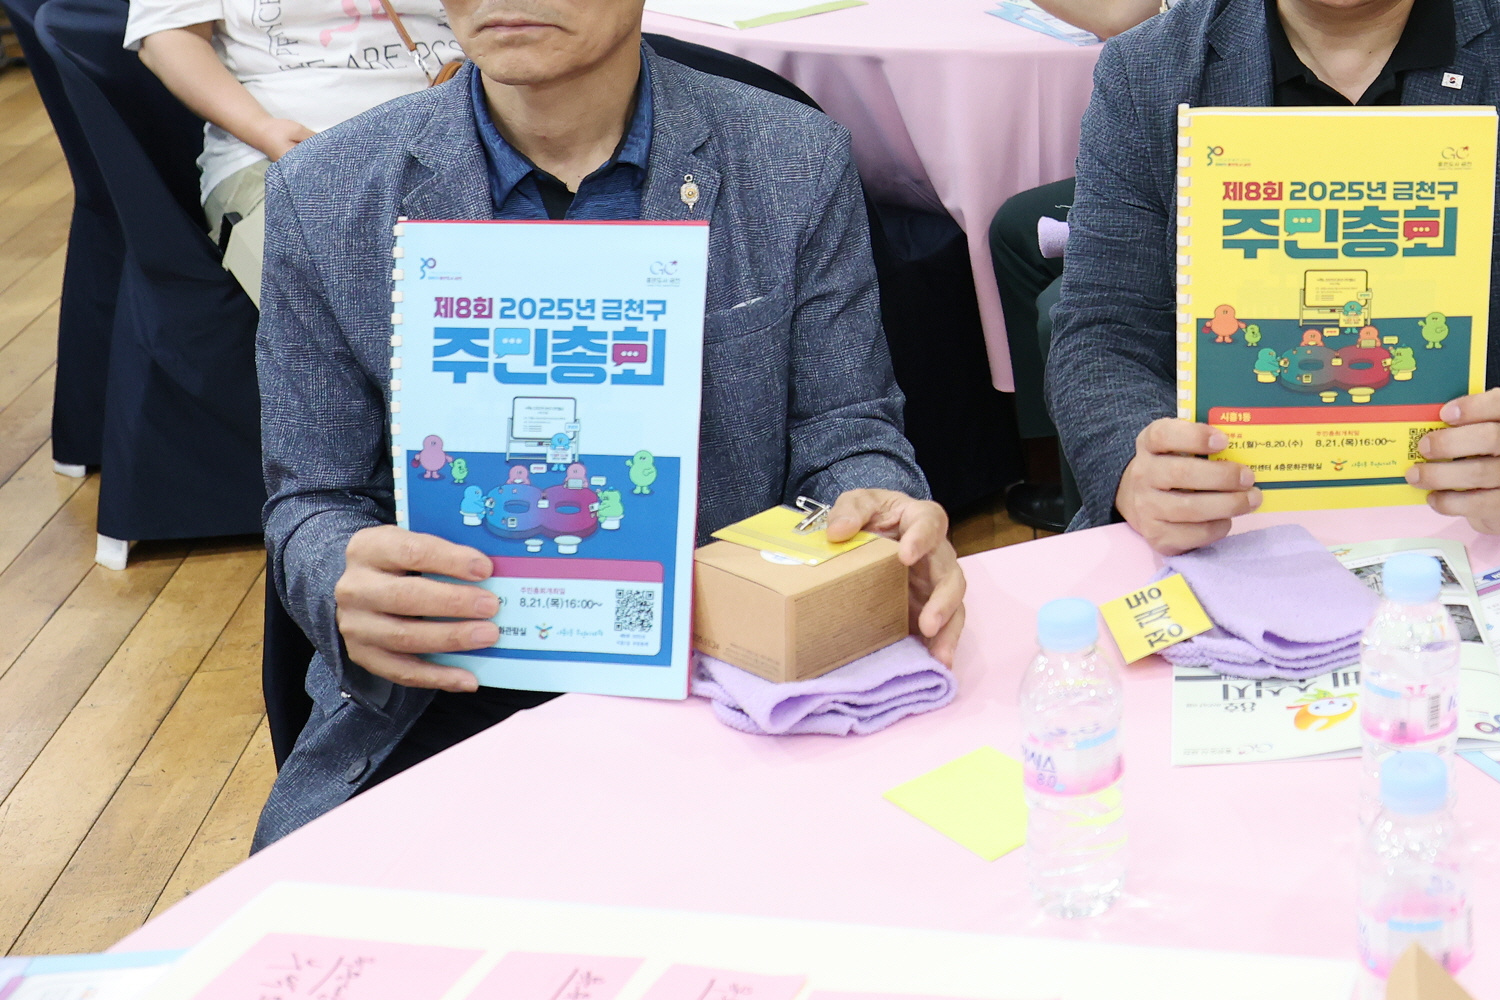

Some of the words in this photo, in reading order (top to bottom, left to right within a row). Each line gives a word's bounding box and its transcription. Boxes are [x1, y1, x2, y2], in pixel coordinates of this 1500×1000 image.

[1222, 181, 1284, 201] 제8회
[1289, 181, 1387, 201] 2025년
[1393, 181, 1459, 201] 금천구
[1222, 205, 1459, 260] 주민총회
[434, 296, 494, 320] 제8회
[499, 297, 596, 321] 2025년
[601, 298, 668, 322] 금천구
[432, 325, 667, 386] 주민총회
[1220, 411, 1252, 423] 시흥1동
